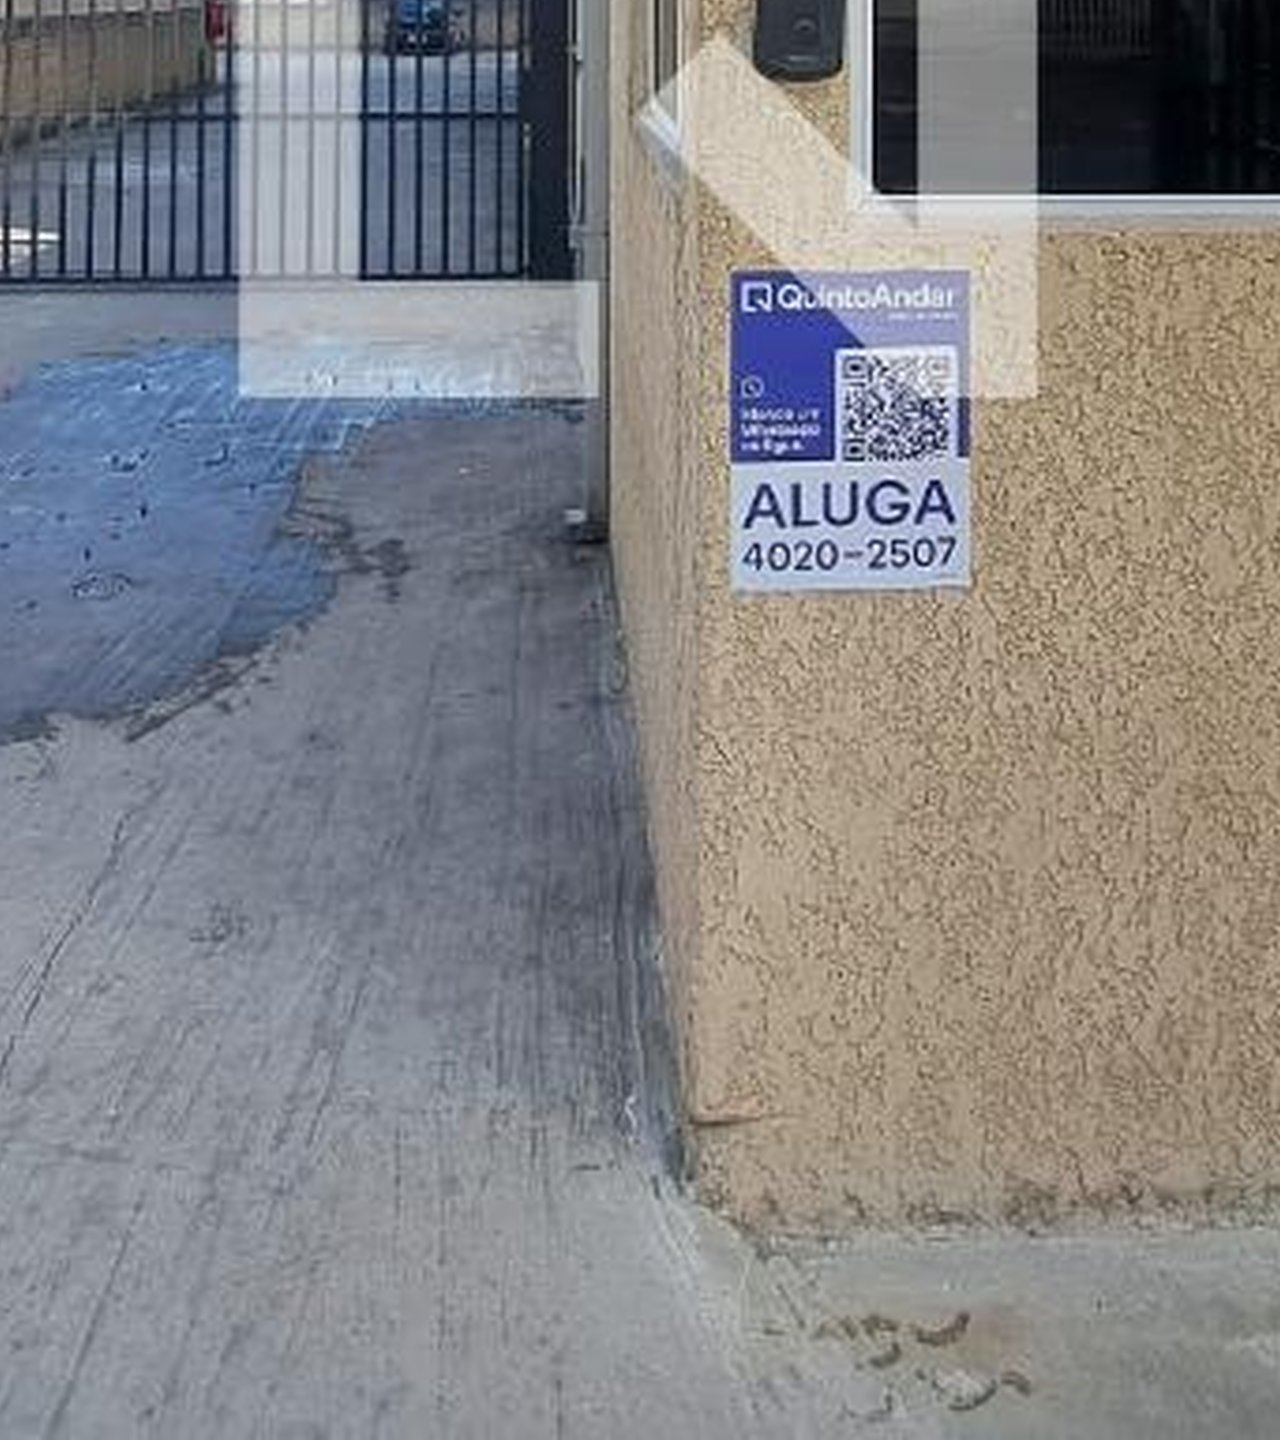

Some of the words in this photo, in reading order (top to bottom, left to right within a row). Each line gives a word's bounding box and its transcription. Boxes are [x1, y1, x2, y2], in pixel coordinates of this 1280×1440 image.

[777, 282, 954, 310] QuintoAndar
[742, 478, 957, 530] ALUGA
[741, 535, 958, 572] 4020-2507
